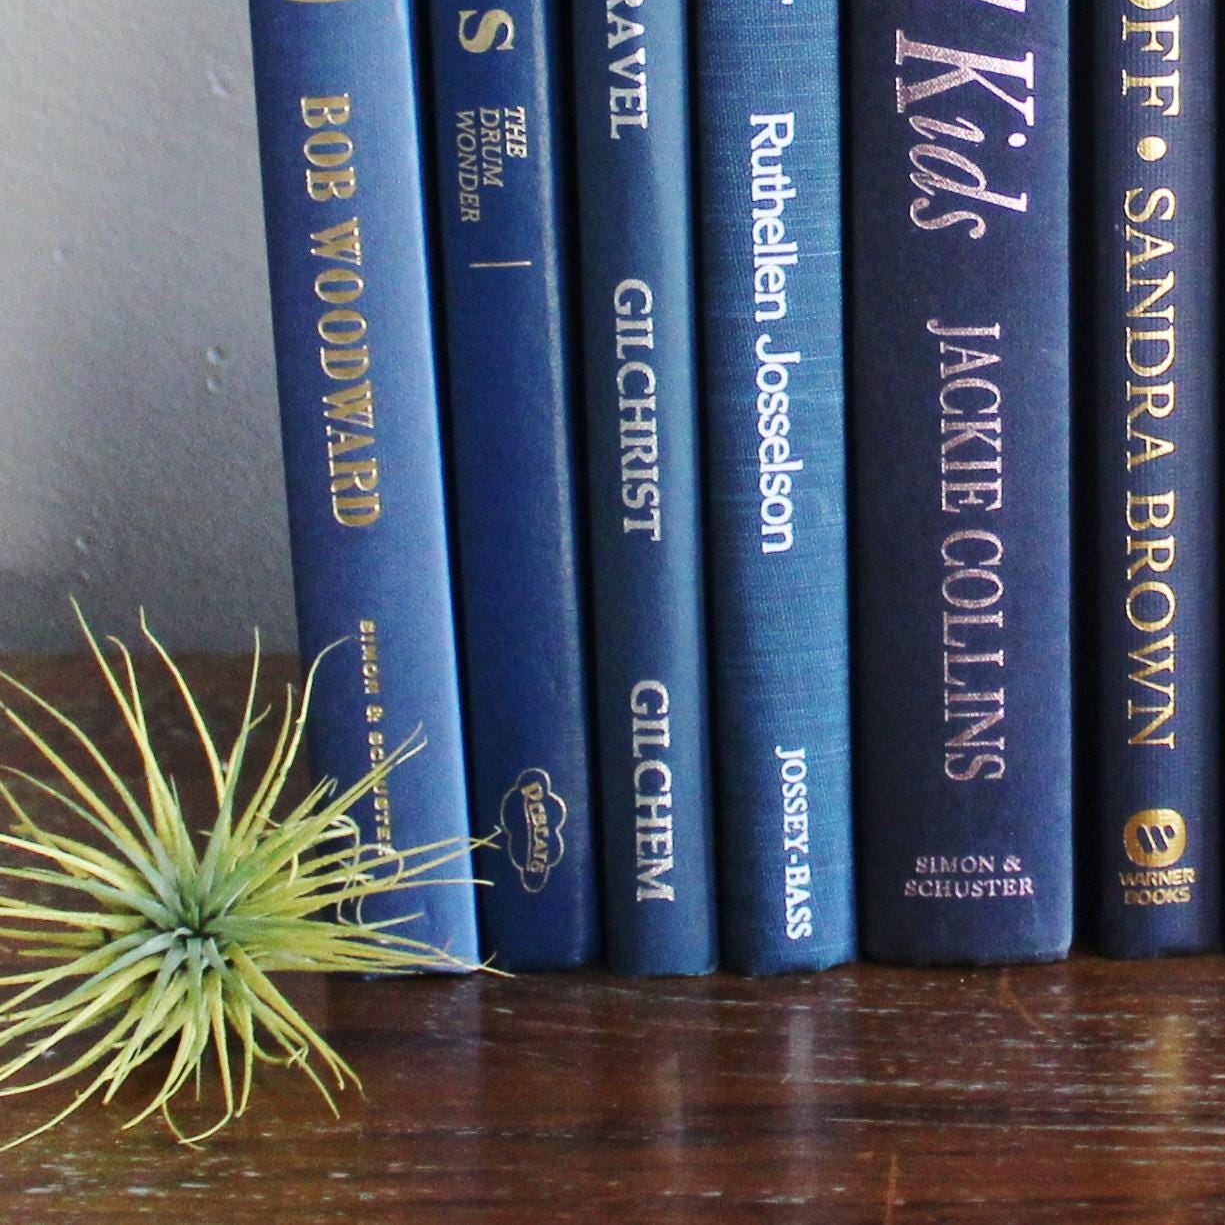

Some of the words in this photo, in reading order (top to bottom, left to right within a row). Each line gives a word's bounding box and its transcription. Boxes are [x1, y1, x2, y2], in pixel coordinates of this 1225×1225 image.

[301, 93, 355, 202] BOB
[456, 110, 480, 222] WONDER
[480, 106, 504, 188] DRUM
[504, 105, 528, 159] THE
[750, 112, 798, 323] Ruthellen
[894, 28, 1038, 240] Kids
[309, 216, 384, 528] WOODWARD
[613, 277, 664, 542] GILCHRIST
[926, 319, 1005, 515] JACKIE
[1122, 184, 1179, 472] SANDRA
[754, 333, 803, 555] Josselson
[940, 528, 1006, 782] COLLINS
[1124, 488, 1179, 751] BROWN
[630, 678, 678, 903] GILCHEM
[775, 745, 814, 940] JOSSEY-BASS
[904, 877, 1035, 900] SCHUSTER
[914, 855, 997, 875] SIMON
[1003, 855, 1023, 874] &
[1119, 867, 1197, 887] WARNER
